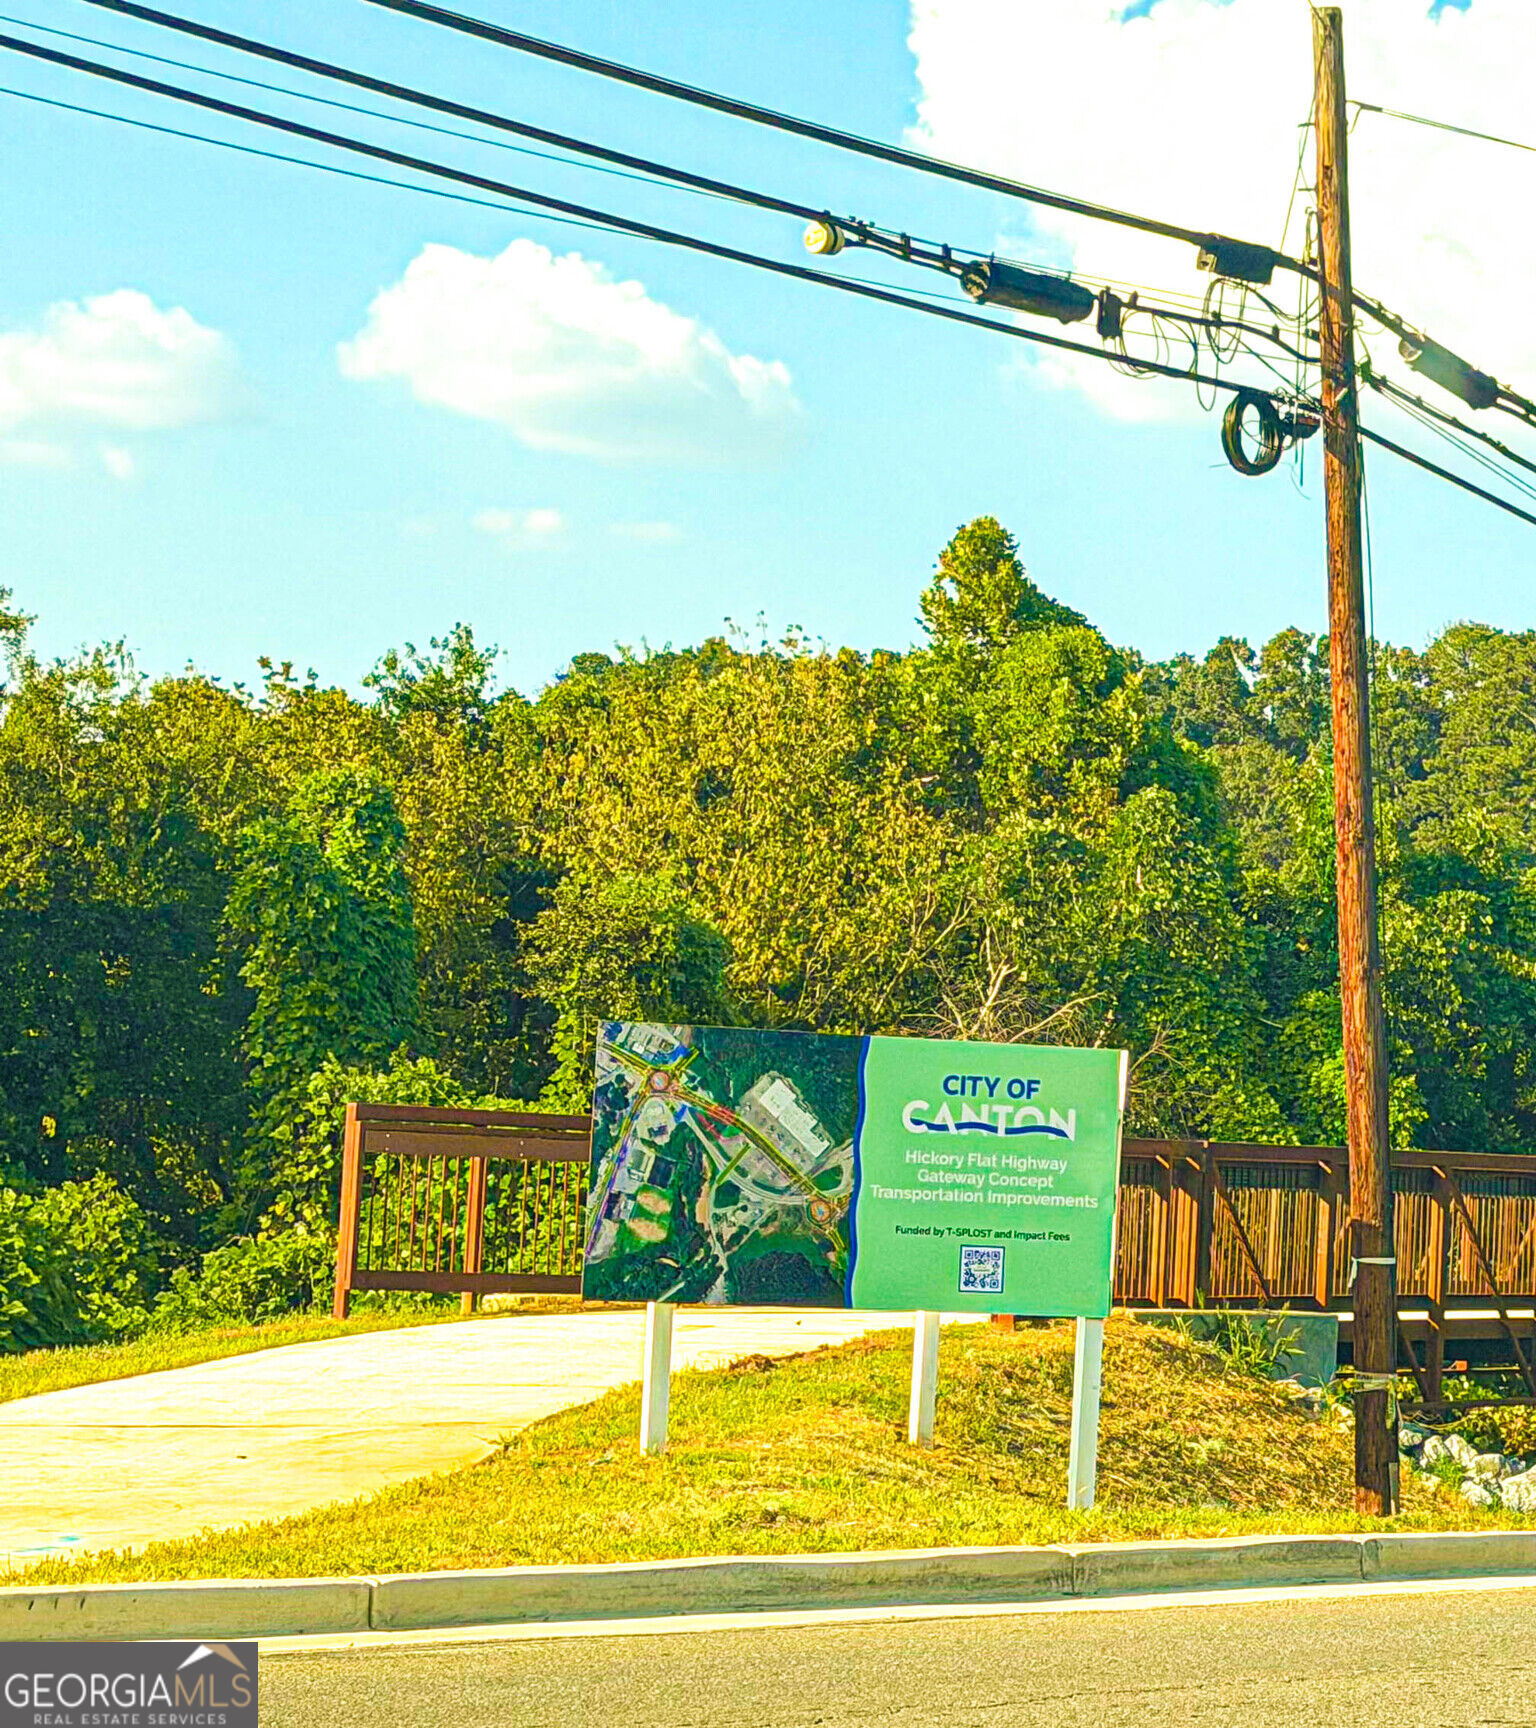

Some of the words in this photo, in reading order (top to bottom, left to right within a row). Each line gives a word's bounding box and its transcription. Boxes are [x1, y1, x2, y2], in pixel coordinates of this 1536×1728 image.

[943, 1075, 1000, 1097] CITY
[1006, 1079, 1041, 1099] OF
[902, 1100, 1076, 1142] CANTON
[905, 1150, 964, 1169] Hickory
[967, 1152, 997, 1168] Flat
[1001, 1154, 1068, 1174] Highway
[917, 1169, 985, 1186] Gateway
[989, 1171, 1053, 1190] Concept
[870, 1184, 983, 1204] Transportation
[988, 1189, 1098, 1209] Improvements
[895, 1225, 931, 1236] Funded
[933, 1226, 945, 1238] by
[946, 1227, 993, 1239] T-SPLOST
[994, 1229, 1012, 1240] and
[1014, 1230, 1046, 1242] Impact
[1048, 1231, 1070, 1242] Fees
